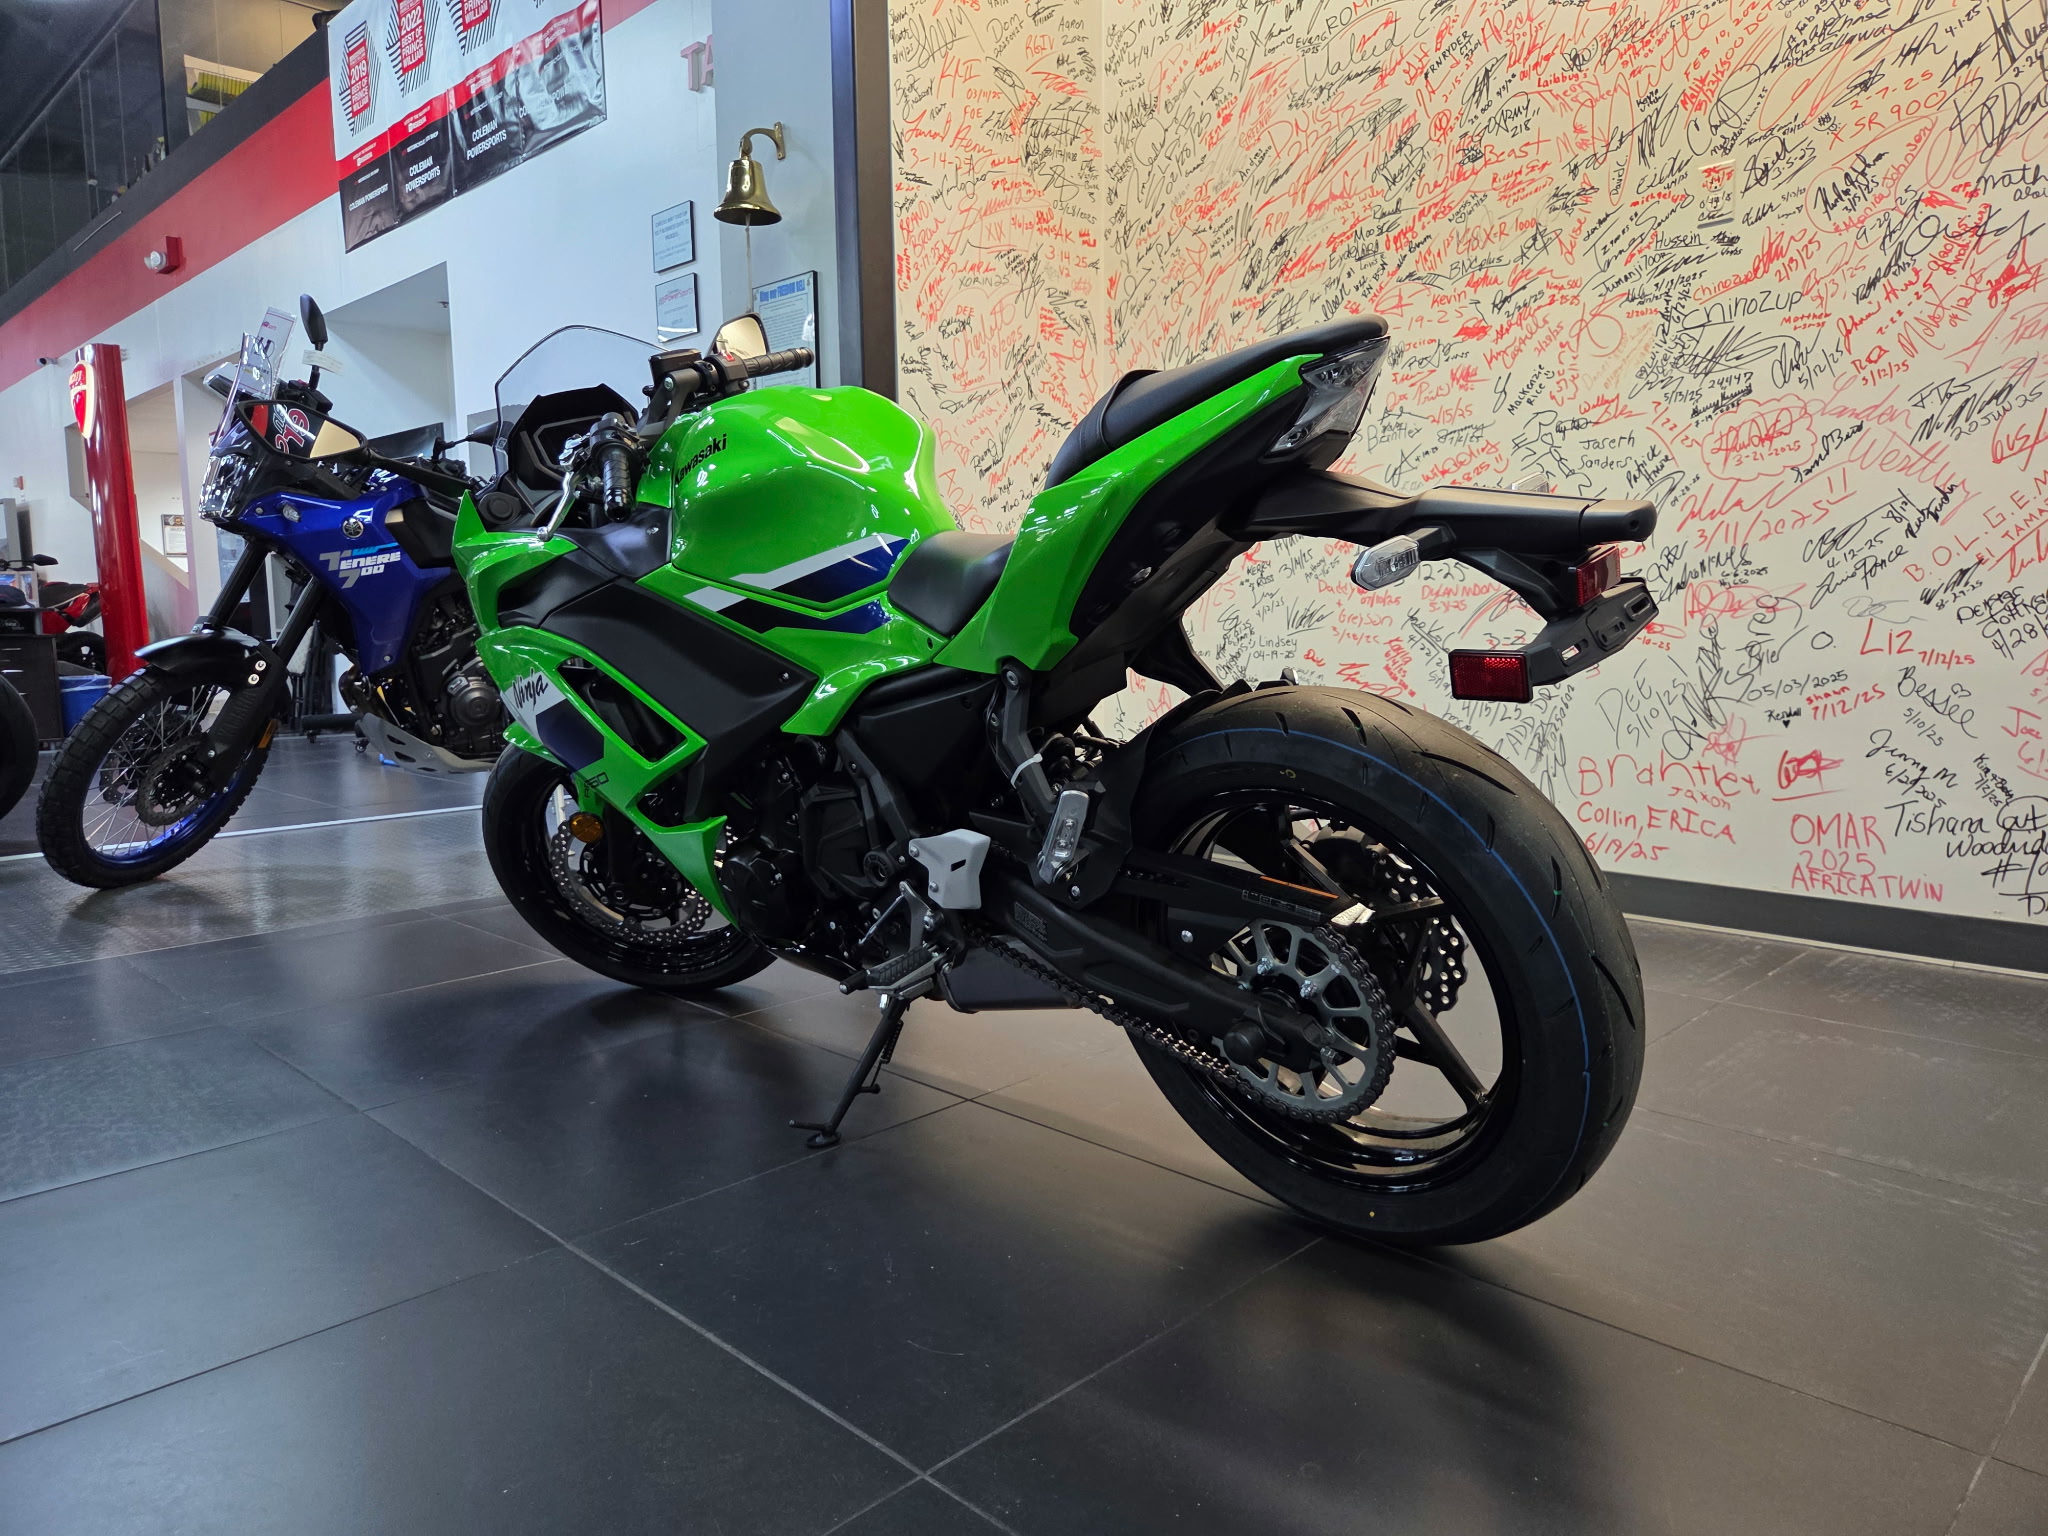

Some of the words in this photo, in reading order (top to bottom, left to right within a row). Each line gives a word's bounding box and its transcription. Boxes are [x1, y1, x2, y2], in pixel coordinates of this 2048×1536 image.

[401, 6, 422, 36] 2022
[465, 3, 488, 24] WILLIAM
[1945, 5, 1981, 37] 4-1-25
[402, 31, 415, 47] BEST
[415, 26, 423, 37] OF
[987, 14, 1020, 43] Dom
[1061, 35, 1089, 45] 2025
[402, 36, 423, 58] PRINCE
[403, 48, 423, 68] WILLIAM
[350, 60, 367, 84] 2019
[967, 88, 1002, 102] 03/11/25
[472, 119, 498, 142] COLEMAN
[1511, 118, 1531, 138] 218
[466, 130, 507, 160] POWERSPORTS
[409, 156, 433, 176] COLEMAN
[406, 166, 440, 193] POWERSPORTS
[1515, 217, 1537, 231] 1000
[1655, 230, 1707, 249] Hussein
[1045, 245, 1055, 260] 3
[1431, 290, 1467, 308] Kevin
[956, 305, 975, 317] DEE
[675, 433, 727, 485] Kawasaki
[1734, 443, 1801, 466] 3-21-2025
[339, 564, 385, 589] 700
[1260, 635, 1297, 652] Lindsey
[1918, 648, 1976, 670] 7/12/25
[512, 667, 548, 710] Ninja
[1812, 683, 1885, 720] 7/12/25
[1647, 805, 1736, 844] ERICA
[1790, 812, 1886, 854] OMAR
[1799, 849, 1877, 877] 2025
[1791, 863, 1876, 898] AFRICA
[1877, 875, 1943, 902] TWIN
